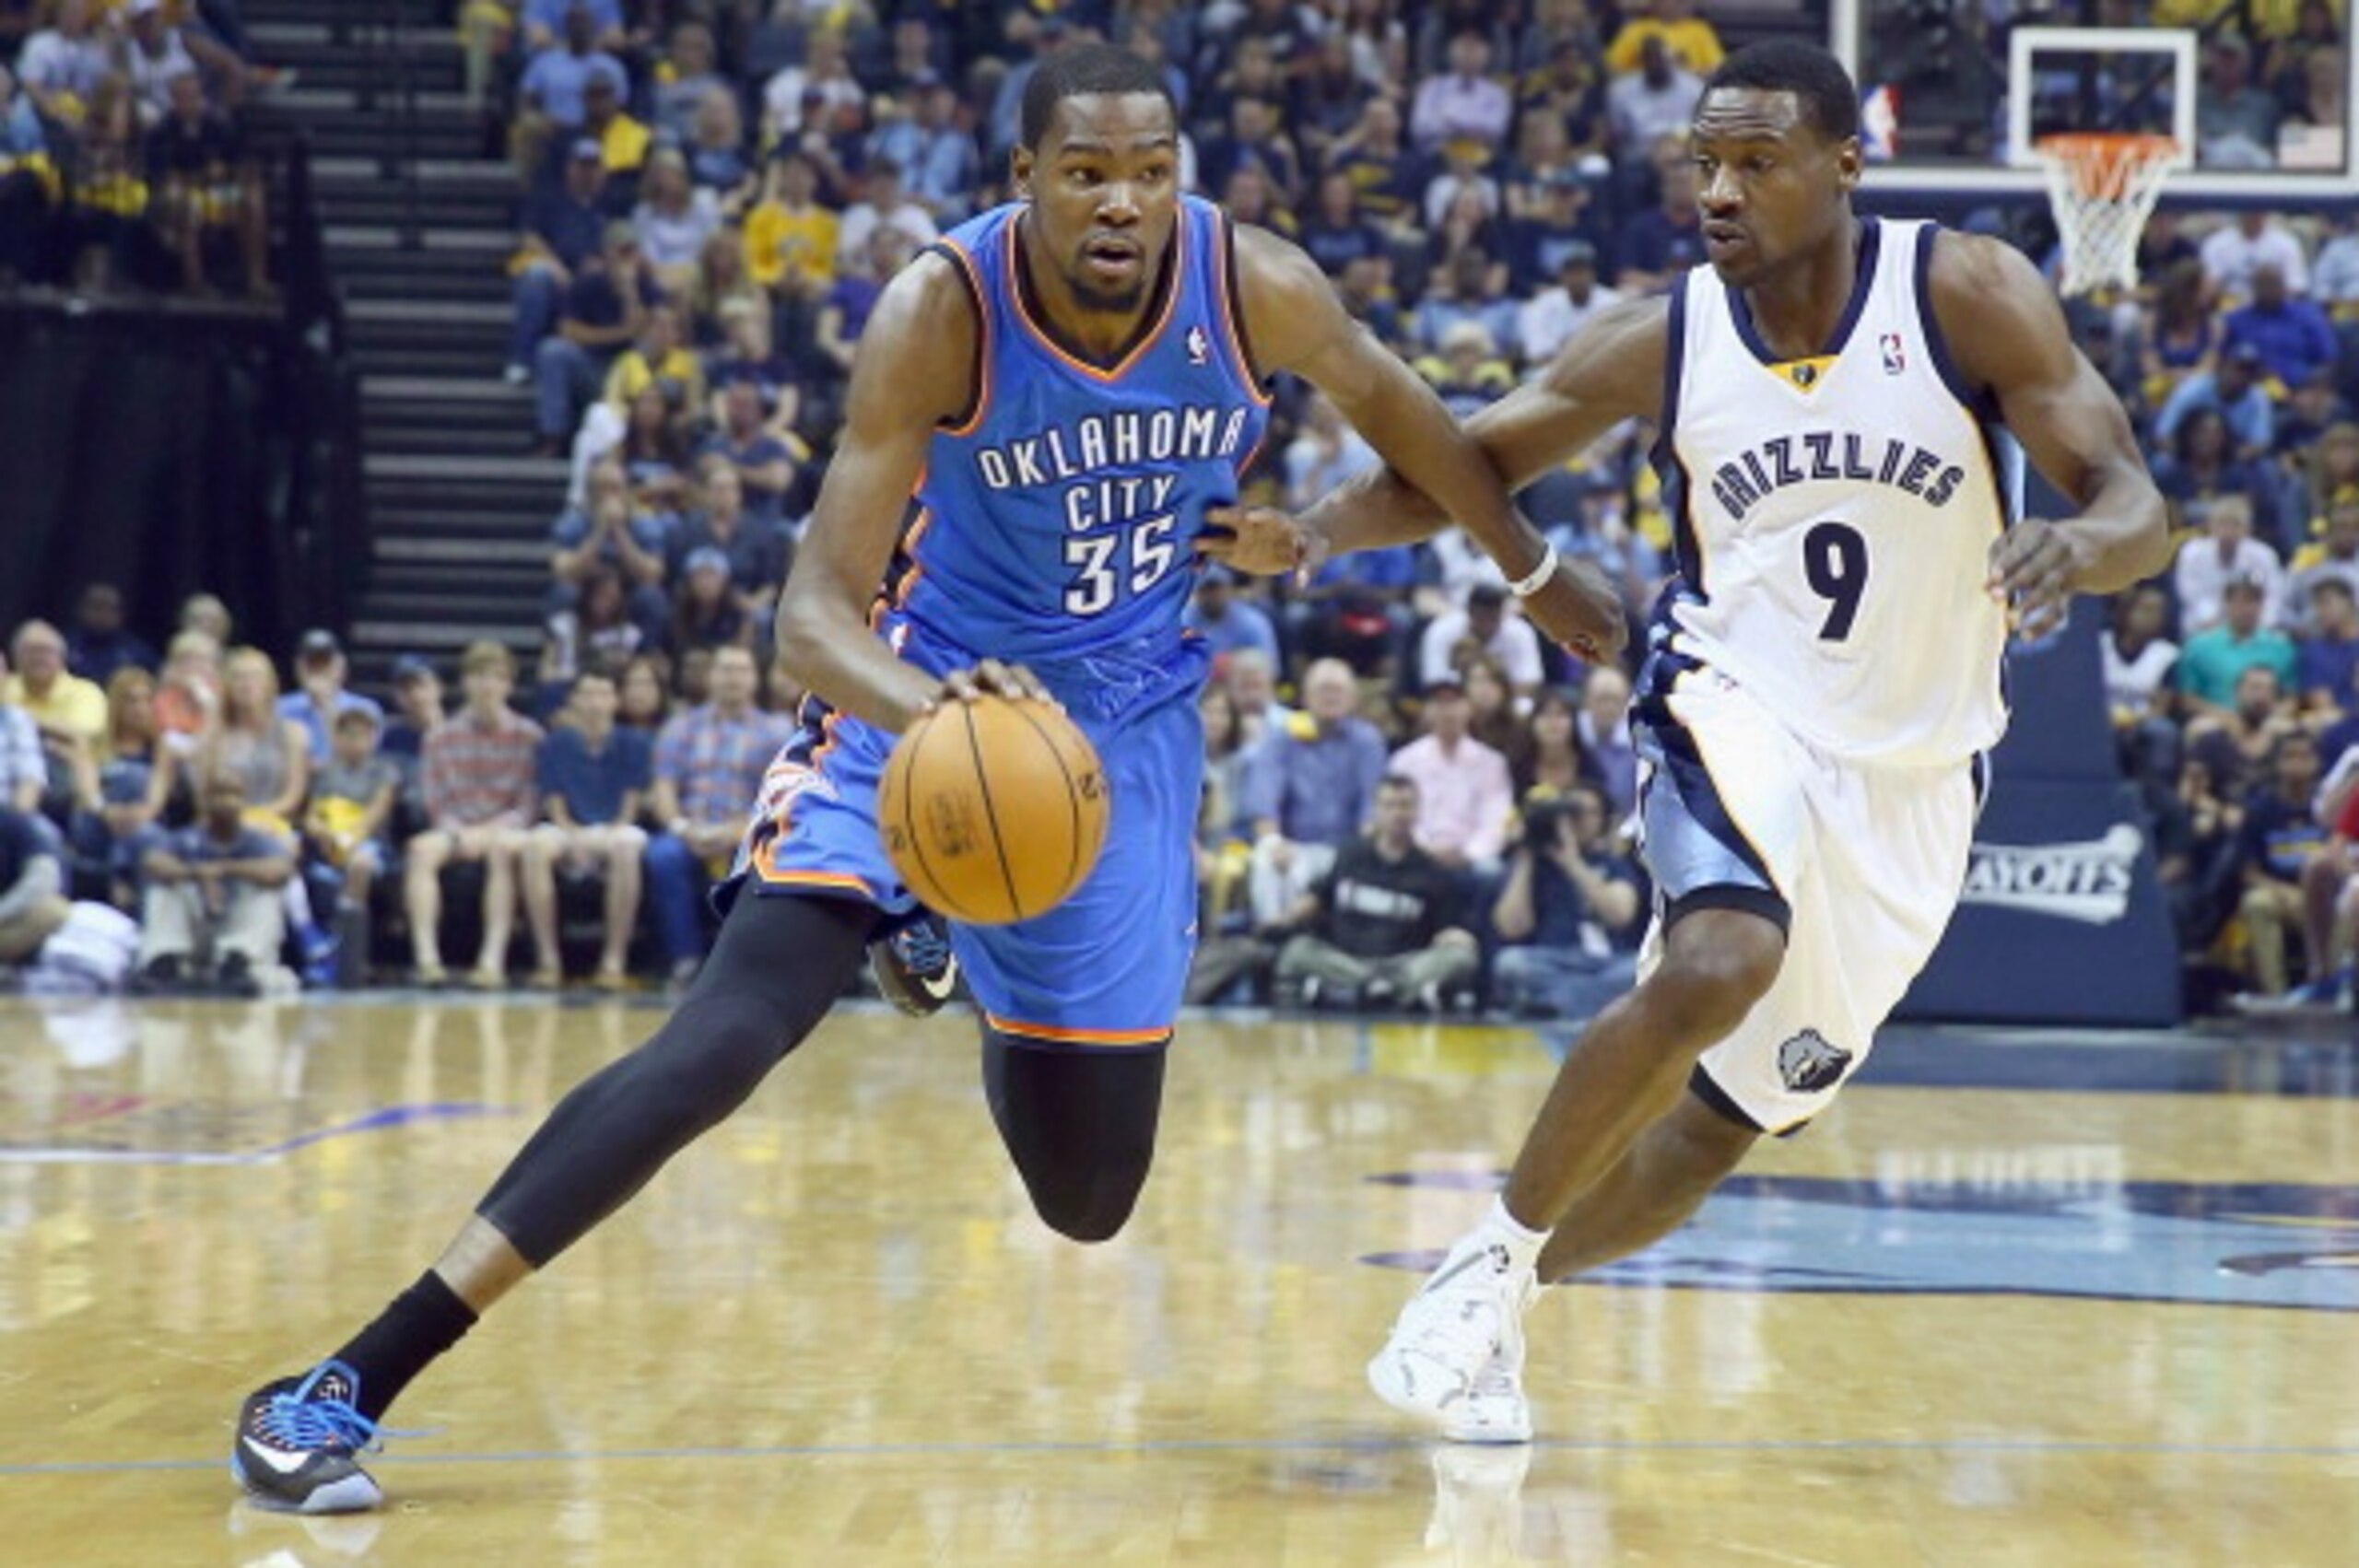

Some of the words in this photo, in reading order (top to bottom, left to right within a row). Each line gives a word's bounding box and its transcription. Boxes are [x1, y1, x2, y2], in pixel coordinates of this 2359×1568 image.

[977, 406, 1247, 490] OKLAHOMA
[1065, 474, 1176, 532] CITY
[1065, 513, 1175, 616] 35
[1802, 521, 1870, 642] 9
[1967, 851, 2133, 895] AYOFFS
